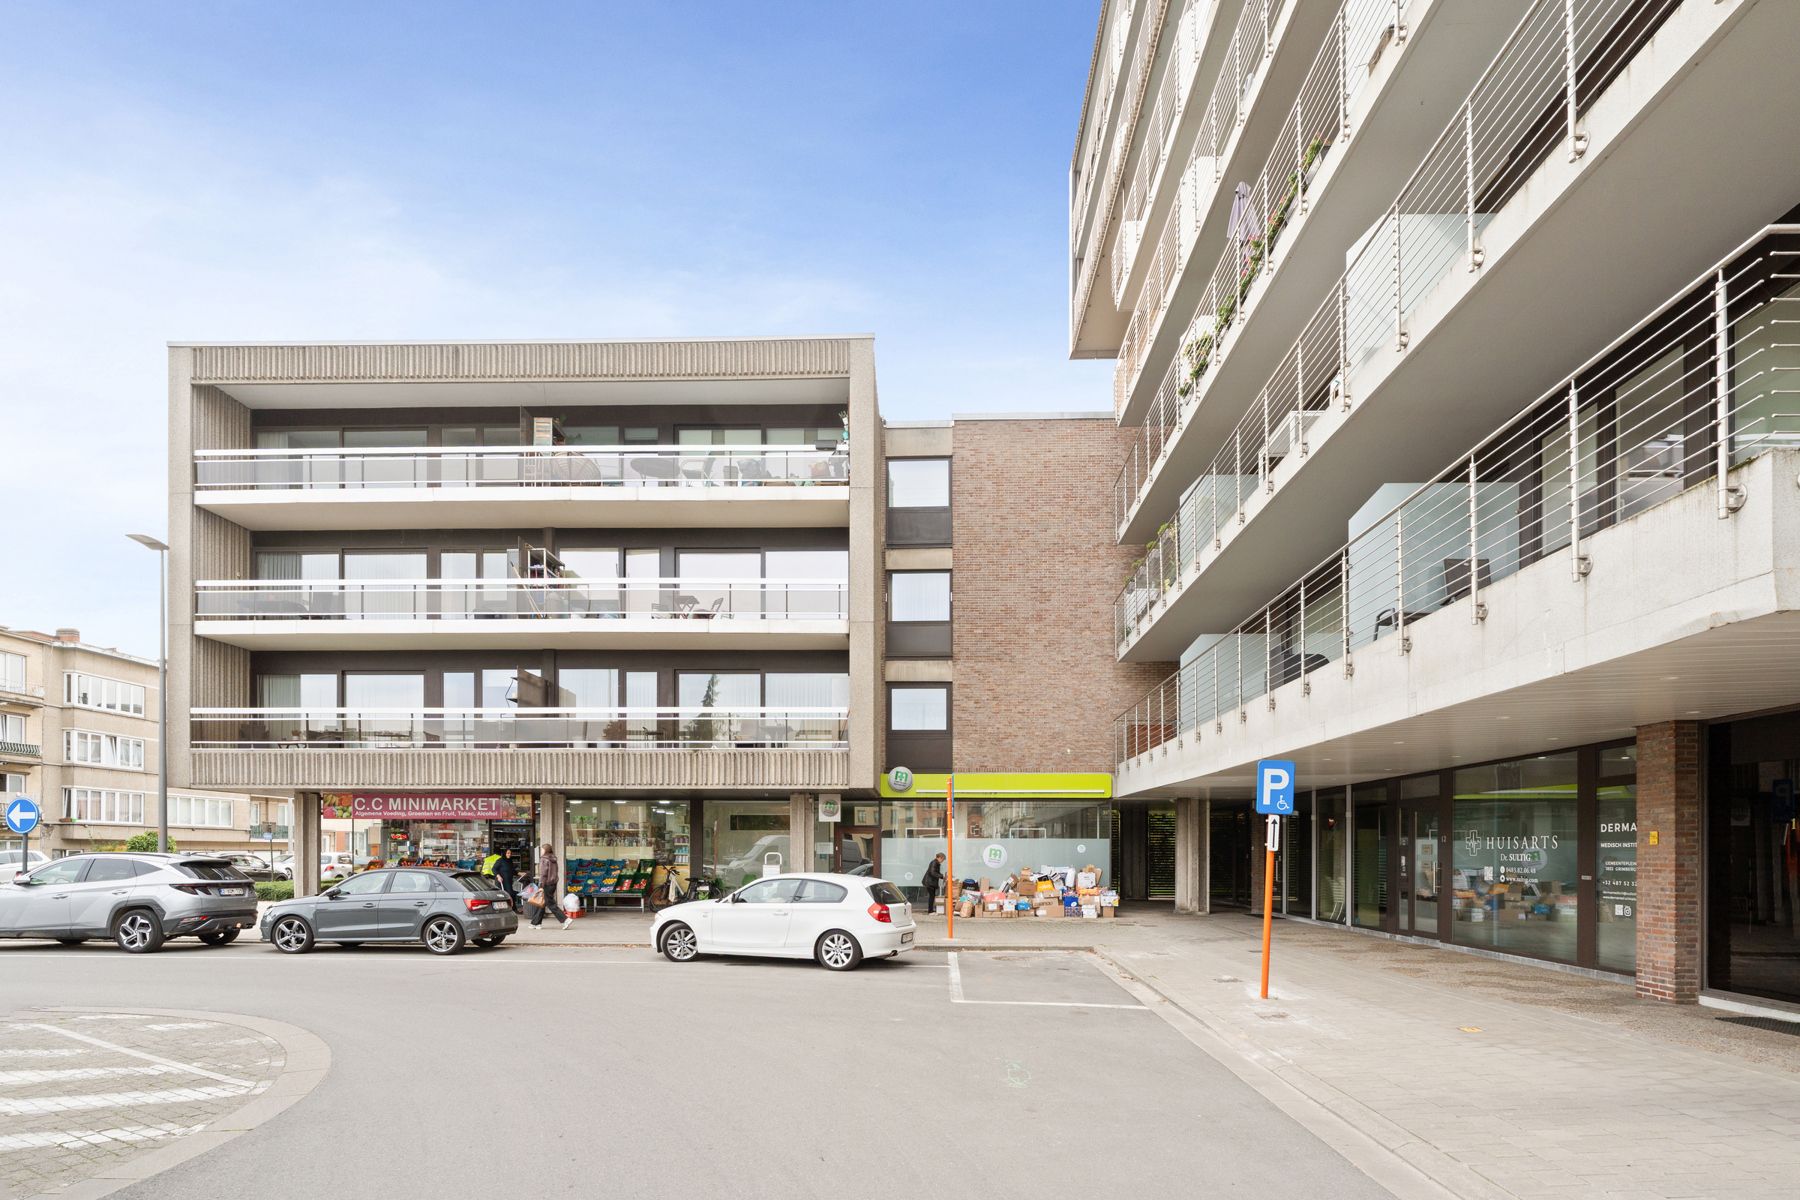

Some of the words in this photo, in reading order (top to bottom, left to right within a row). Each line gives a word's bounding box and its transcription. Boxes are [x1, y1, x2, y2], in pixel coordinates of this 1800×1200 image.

[1263, 768, 1290, 805] P
[354, 797, 383, 811] C.C
[388, 797, 500, 811] MINIMARKET
[355, 810, 382, 818] Algemene
[1600, 822, 1637, 832] DERMA
[1486, 835, 1558, 850] HUISARTS
[1508, 853, 1531, 861] SULTIG
